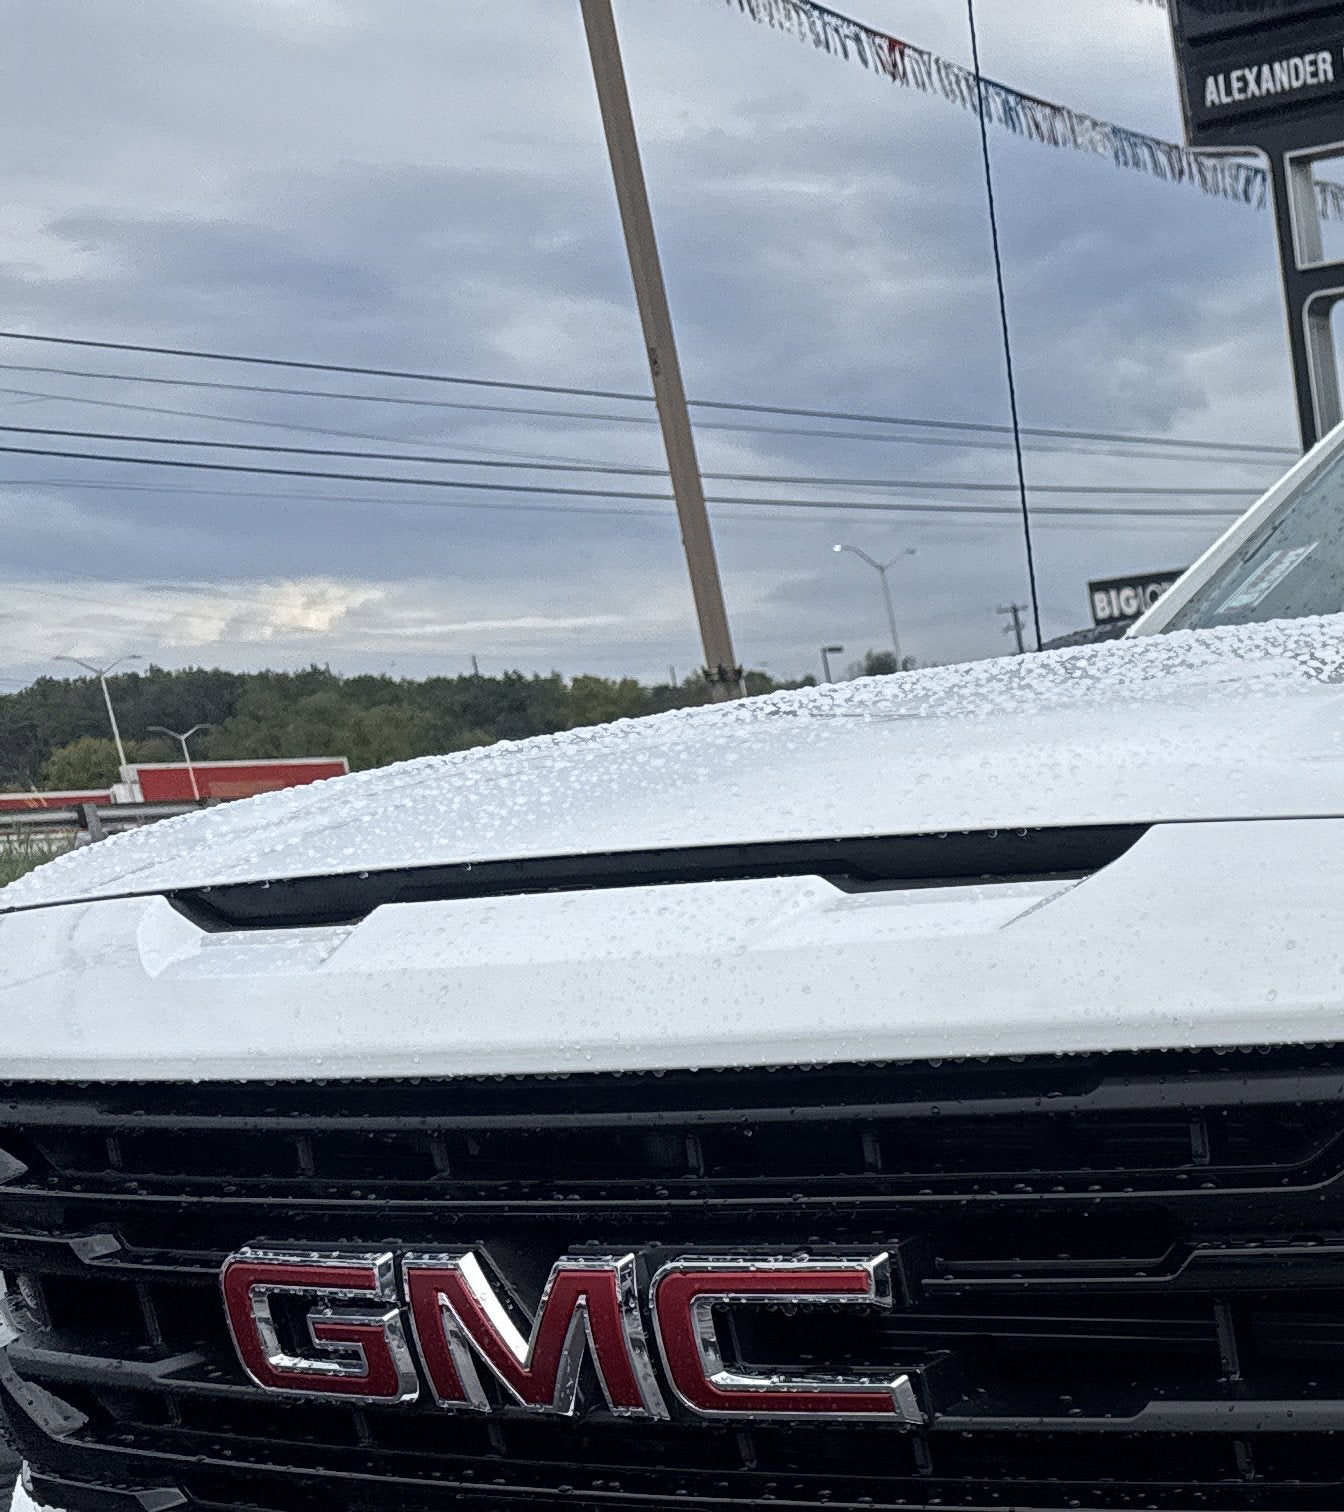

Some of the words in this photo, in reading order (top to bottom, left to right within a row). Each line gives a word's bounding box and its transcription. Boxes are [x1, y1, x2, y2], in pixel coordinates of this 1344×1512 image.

[1204, 50, 1335, 108] ALEXANDER
[1094, 586, 1139, 620] BIG
[219, 1249, 925, 1425] GMC
